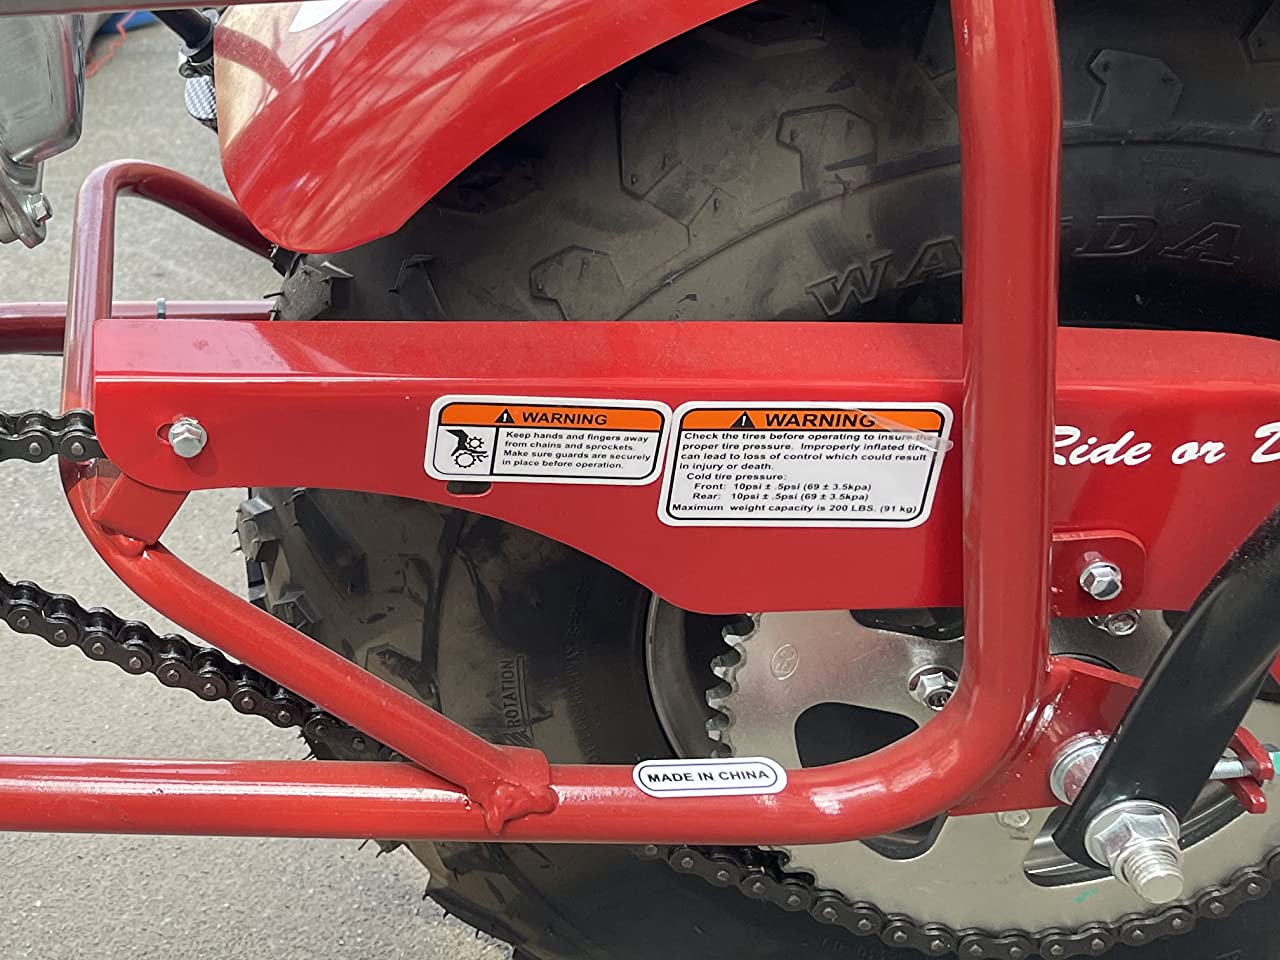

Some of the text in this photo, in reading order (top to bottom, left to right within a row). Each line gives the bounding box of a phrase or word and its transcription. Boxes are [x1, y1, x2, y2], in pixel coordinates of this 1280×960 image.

[805, 215, 1243, 316] WADA
[522, 411, 608, 426] WARNING
[765, 413, 876, 428] WARNING
[506, 431, 649, 444] Keep hands and fingers away
[684, 432, 719, 440] Check
[721, 432, 739, 440] the
[742, 432, 766, 440] tires
[769, 432, 805, 440] before
[808, 433, 861, 442] operating
[878, 433, 913, 441] insure
[504, 440, 635, 452] from chains and sprockets.
[682, 442, 930, 452] proper tire pressure. Improperly inflated tire
[503, 450, 528, 458] Make
[555, 451, 589, 461] guards
[609, 453, 651, 462] securely
[783, 453, 823, 461] control
[825, 453, 858, 461] which
[861, 453, 892, 461] could
[1171, 441, 1226, 464] or
[513, 459, 540, 469] place
[542, 460, 573, 468] before
[575, 461, 624, 470] operation.
[692, 463, 724, 471] injury
[686, 472, 712, 480] Cold
[735, 473, 787, 482] pressure:
[733, 483, 762, 491] 10psi
[803, 483, 820, 491] (69
[832, 483, 872, 492] 3.5kpa)
[731, 493, 760, 501] 10psi
[800, 493, 818, 501] (69
[829, 493, 869, 502] 3.5kpa)
[672, 503, 917, 514] Maximum weight capacity is 200 LBS. (91 kg)
[500, 658, 521, 729] ROTATION
[647, 770, 770, 783] MADE IN CHINA
